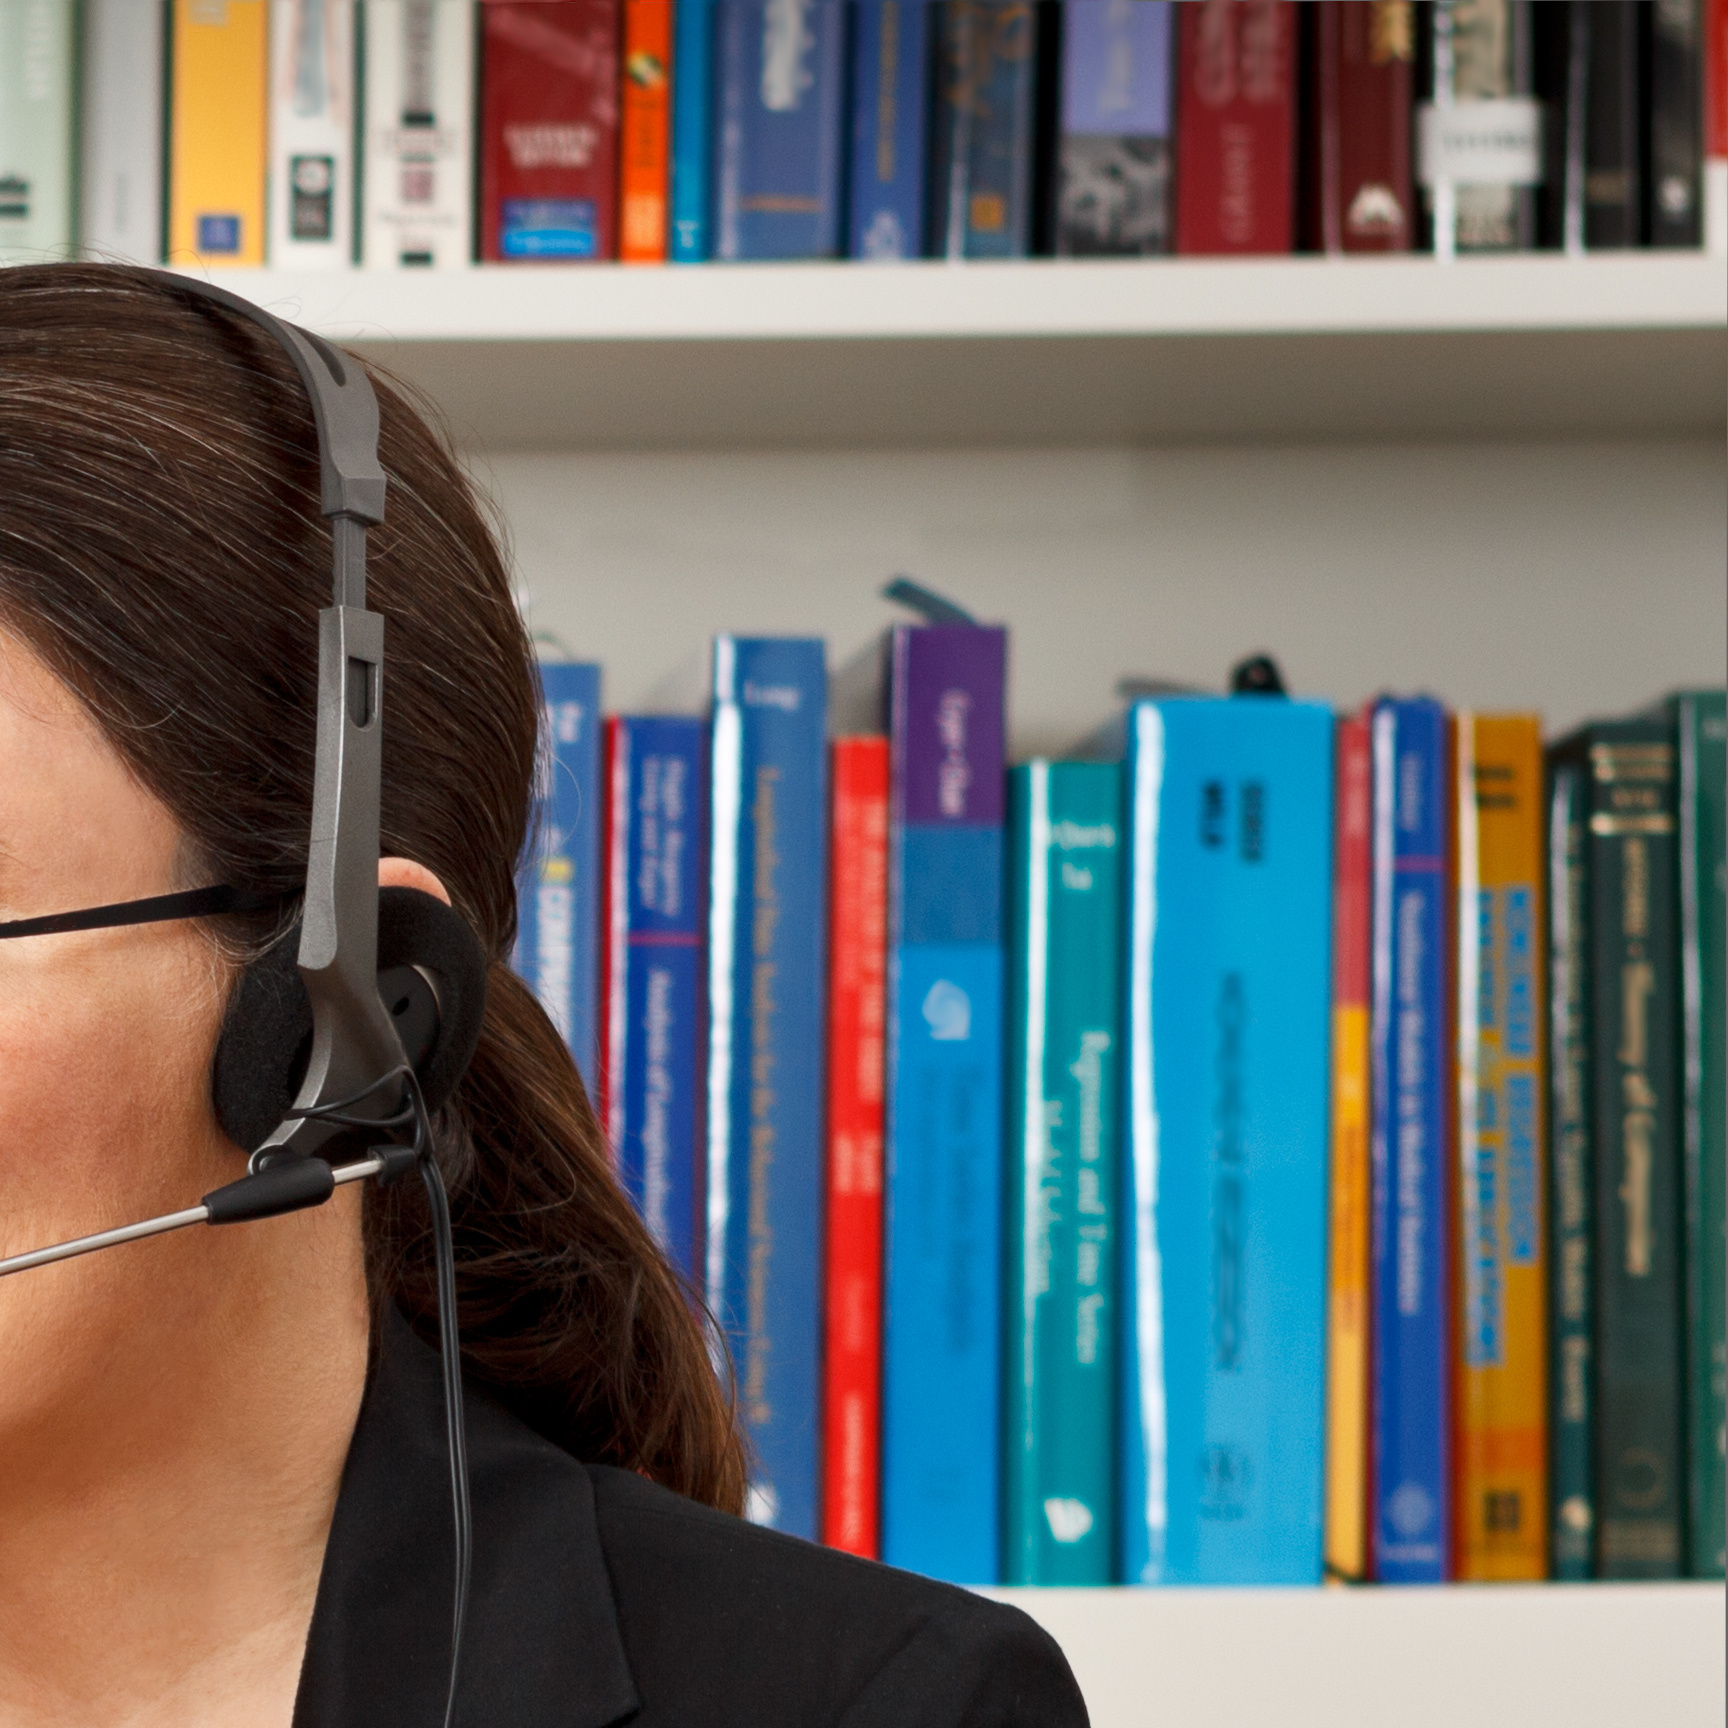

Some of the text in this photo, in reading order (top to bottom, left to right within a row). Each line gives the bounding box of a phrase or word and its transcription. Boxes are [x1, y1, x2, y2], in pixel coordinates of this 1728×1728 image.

[644, 969, 673, 1065] Analysis
[646, 1067, 673, 1095] of
[1503, 887, 1539, 1266] NONLINEAR REGRESSION
[1069, 1029, 1112, 1366] Regression and Time Series
